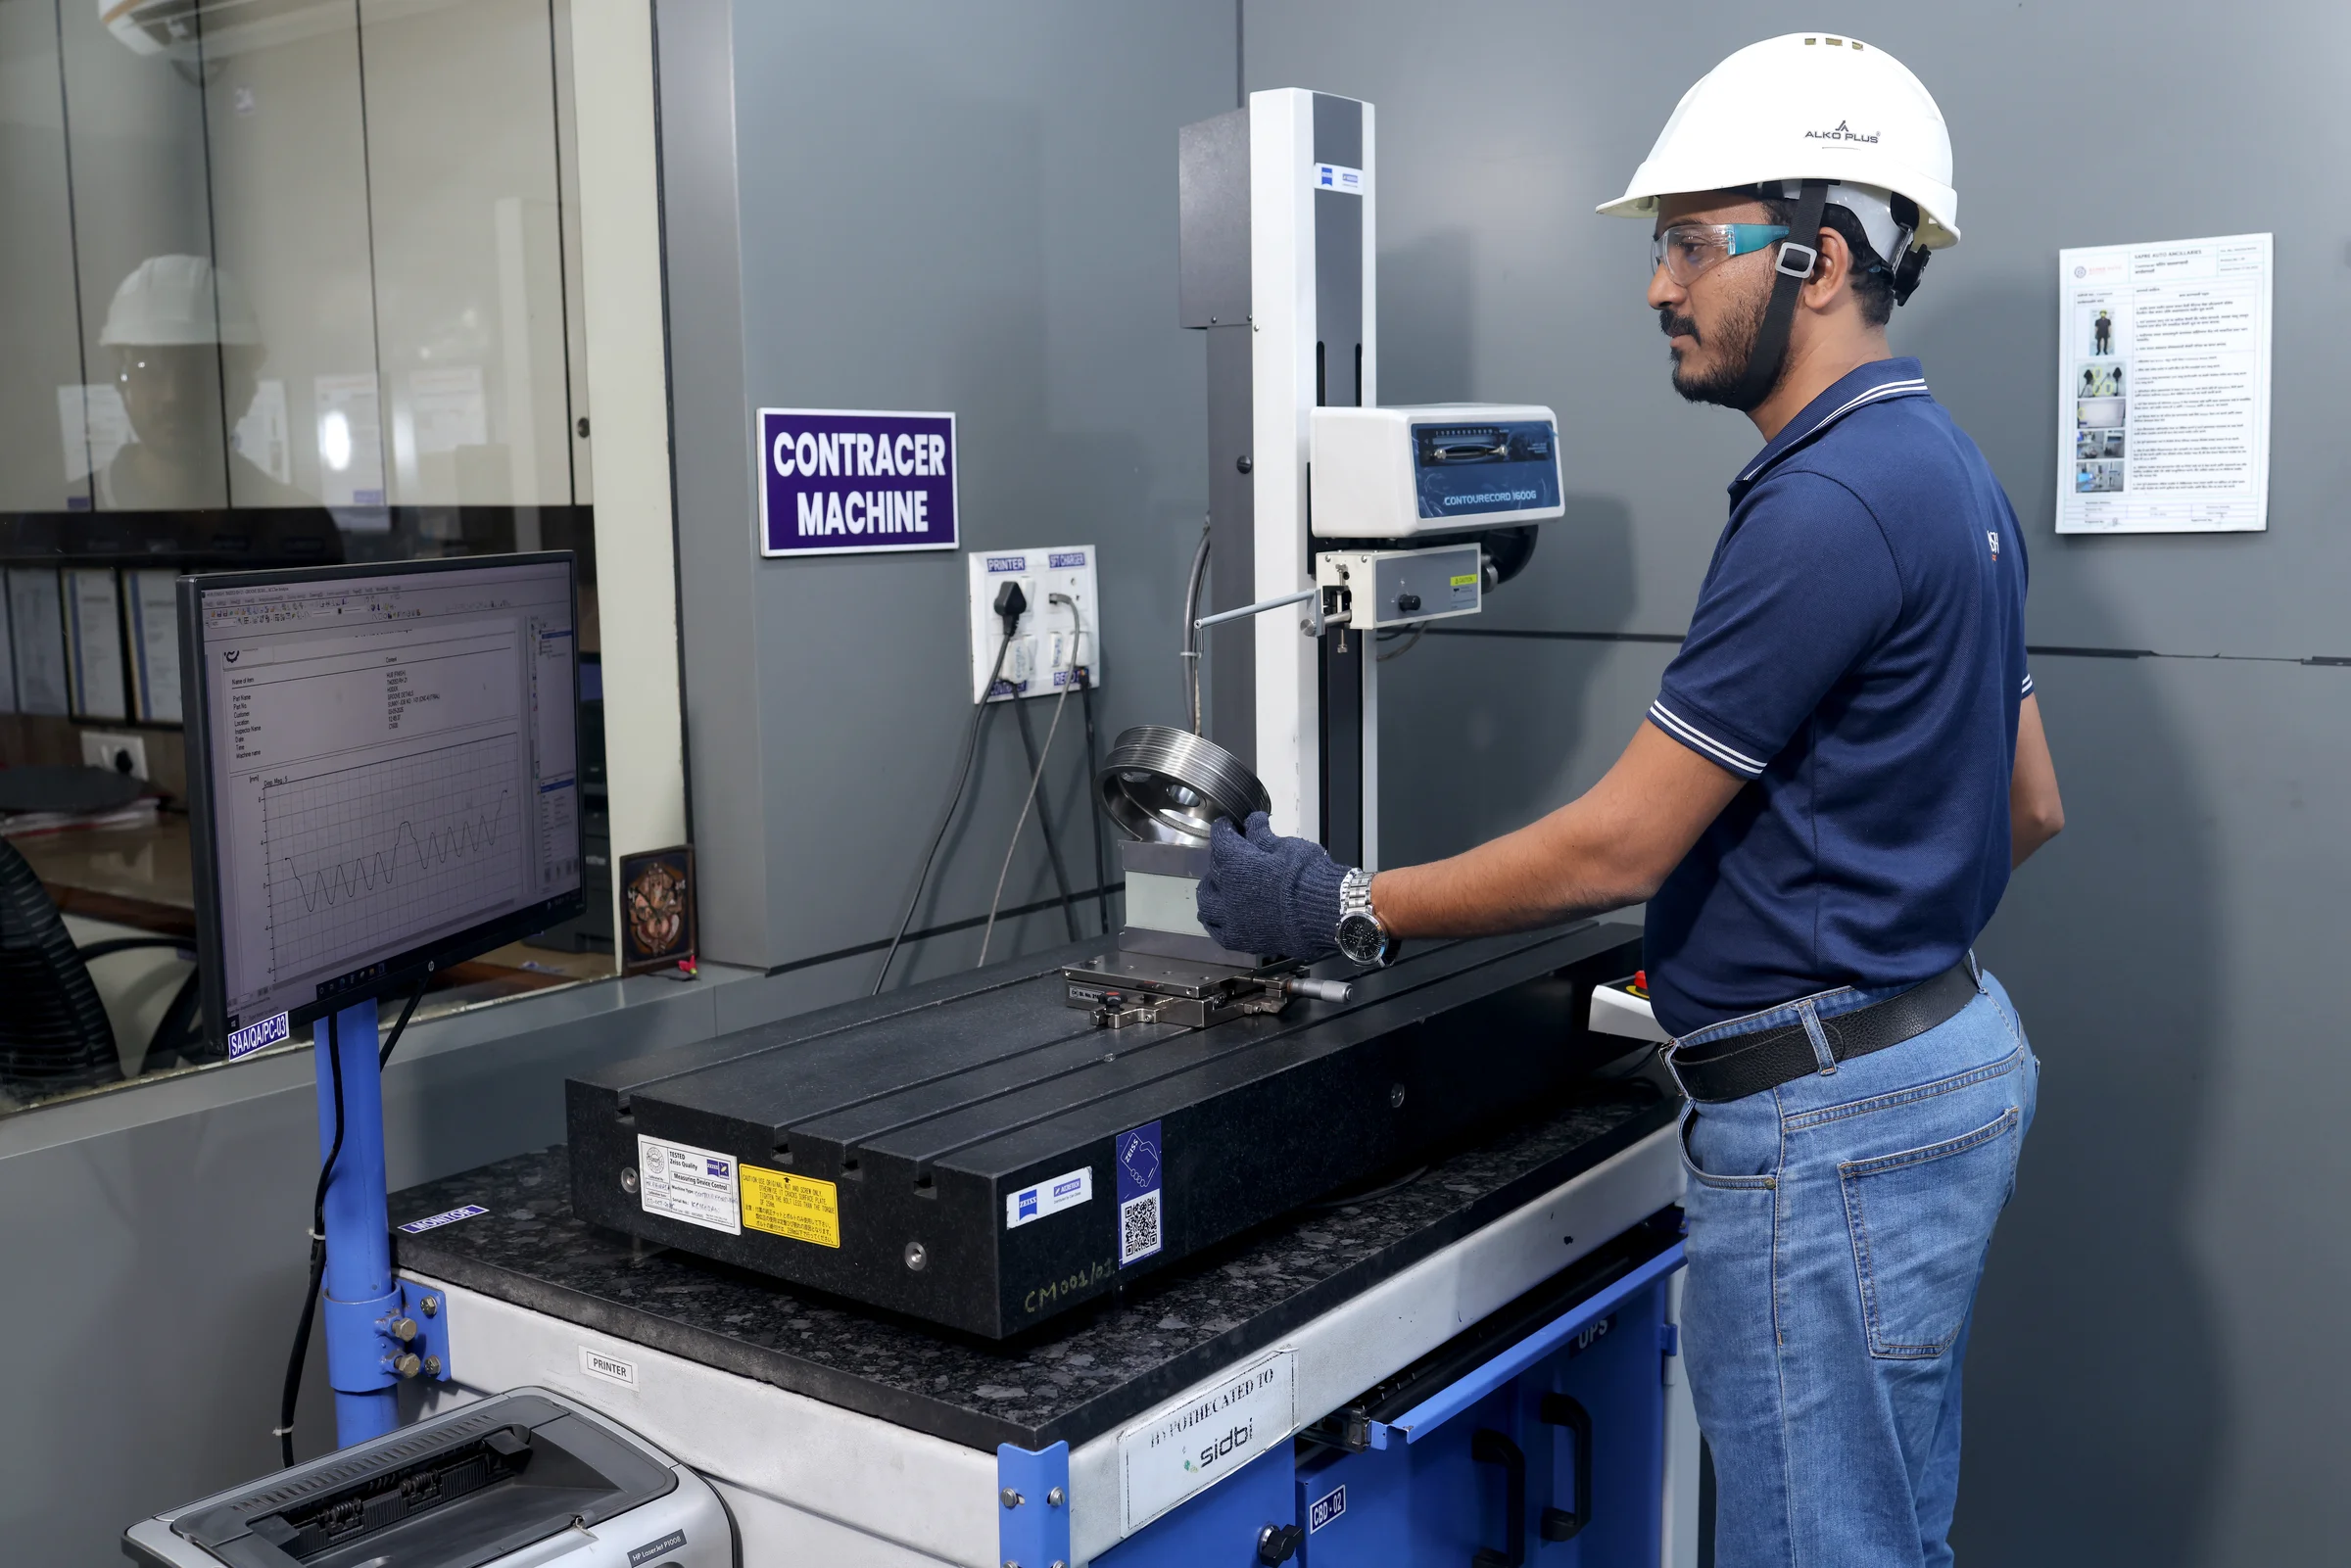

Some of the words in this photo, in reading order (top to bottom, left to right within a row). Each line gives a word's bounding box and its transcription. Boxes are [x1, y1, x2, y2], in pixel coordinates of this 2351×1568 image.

[1804, 130, 1842, 140] ALKO
[1845, 133, 1879, 144] PLUS
[773, 431, 946, 478] CONTRACER
[1444, 492, 1511, 506] CONTOURECORD
[1512, 490, 1537, 501] 1600G
[796, 490, 929, 537] MACHINE
[987, 558, 1025, 571] PRINTER
[231, 1016, 286, 1056] SAA/QA/PC-03
[669, 1151, 686, 1161] TESTED
[1125, 1138, 1138, 1164] ZEISS
[682, 1162, 698, 1171] Quality
[673, 1173, 696, 1185] Measuring
[696, 1178, 711, 1188] Device
[711, 1181, 728, 1191] Control
[1020, 1196, 1037, 1209] ZEISS
[410, 1209, 476, 1230] MONITOR
[1578, 1319, 1607, 1350] UPS
[593, 1357, 627, 1377] PRINTER
[1257, 1368, 1274, 1389] TO
[1200, 1417, 1253, 1468] sidbi
[1314, 1501, 1328, 1526] CBD
[1333, 1492, 1342, 1513] 02
[632, 1552, 642, 1562] HP
[642, 1544, 664, 1557] LaserJet
[663, 1535, 682, 1548] P1008
